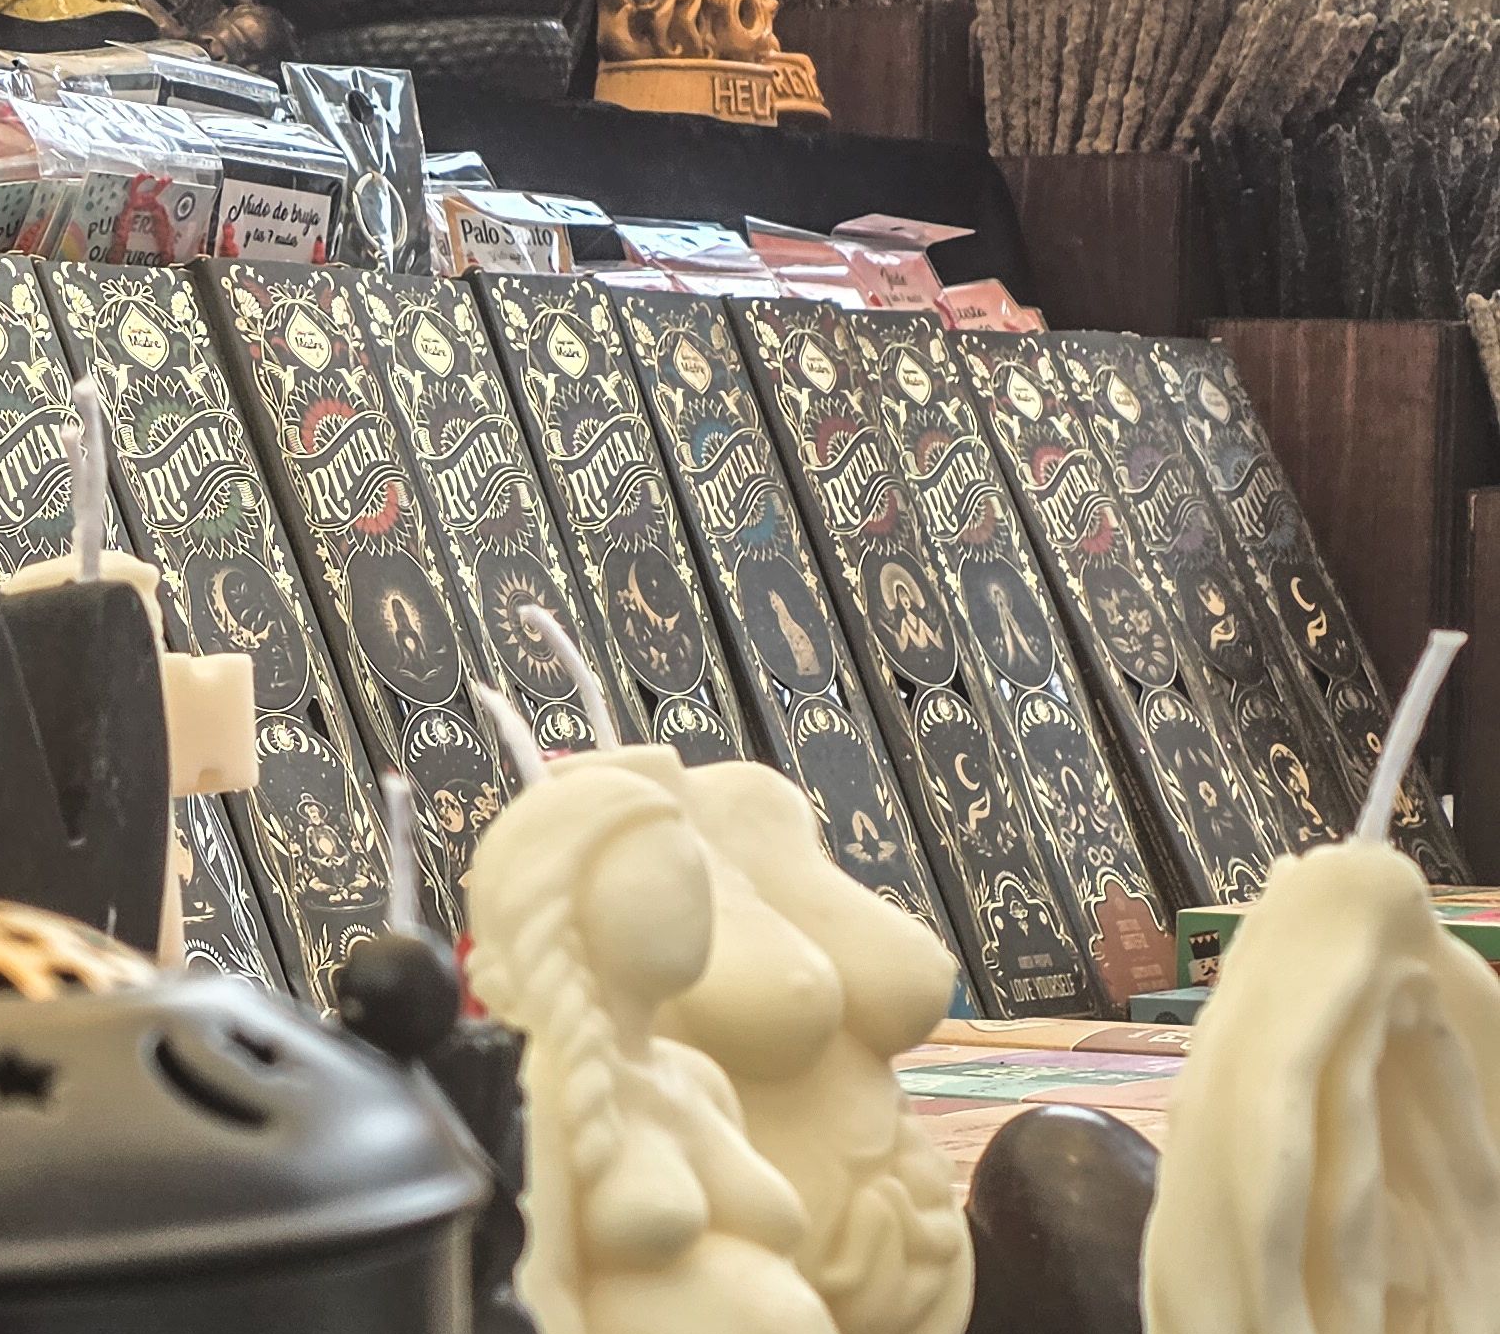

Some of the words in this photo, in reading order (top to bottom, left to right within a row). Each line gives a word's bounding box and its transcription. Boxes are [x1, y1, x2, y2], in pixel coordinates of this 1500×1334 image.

[461, 218, 500, 245] Palo
[141, 426, 235, 522] RITUAL
[307, 428, 391, 521] RITUAL
[437, 431, 513, 521] RITUAL
[567, 430, 645, 520] RITUAL
[699, 444, 767, 529] RITUAL
[823, 442, 890, 527] RITUAL
[923, 451, 987, 534] RITUAL
[1042, 464, 1101, 540] RITUAL
